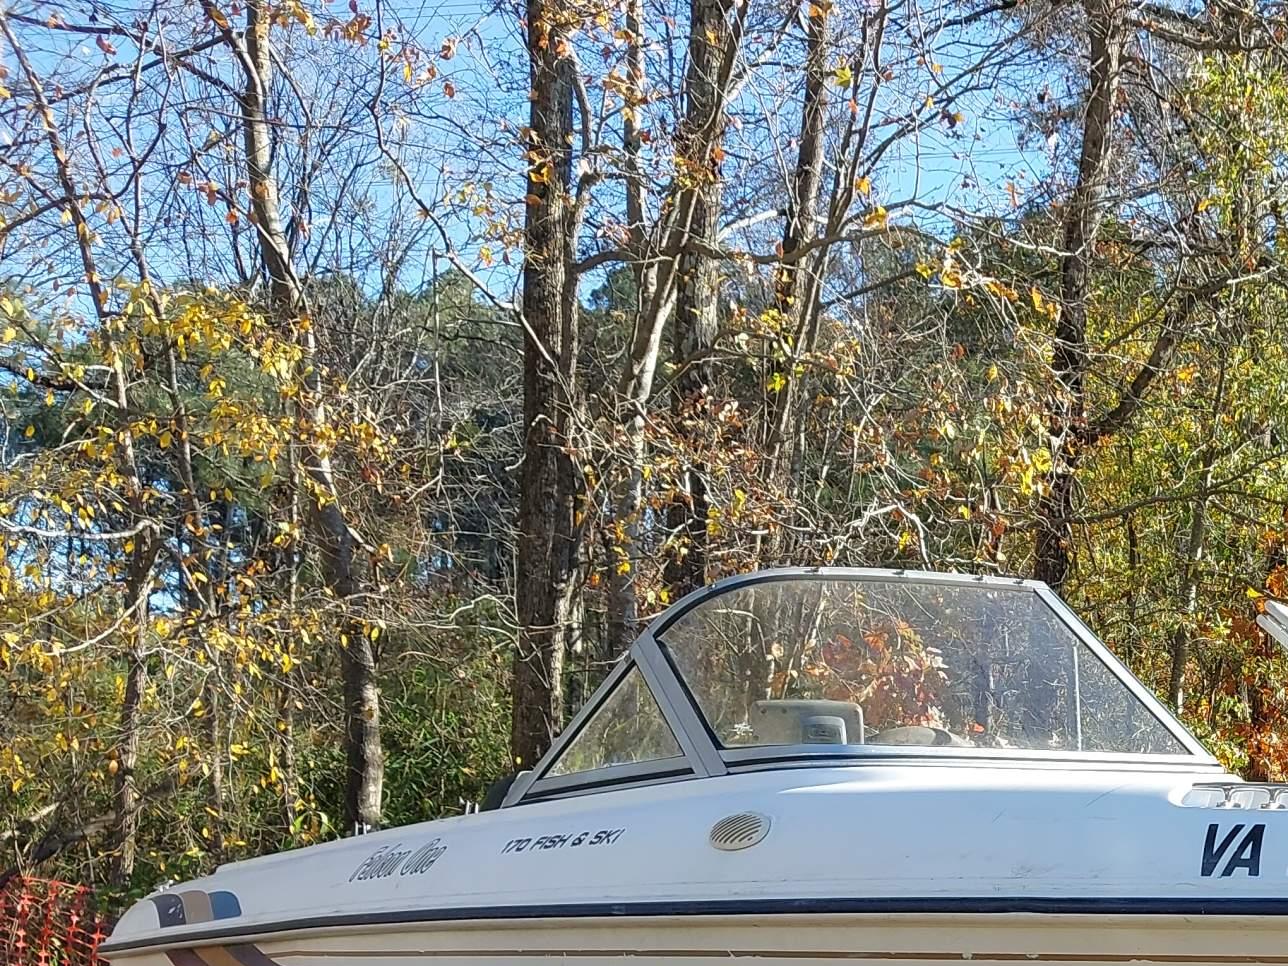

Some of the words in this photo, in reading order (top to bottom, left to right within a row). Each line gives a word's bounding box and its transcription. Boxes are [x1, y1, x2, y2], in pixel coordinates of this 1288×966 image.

[501, 838, 532, 854] 170
[529, 834, 573, 851] FISH
[571, 832, 590, 847] &
[589, 828, 626, 845] SKI
[1200, 823, 1266, 878] VA
